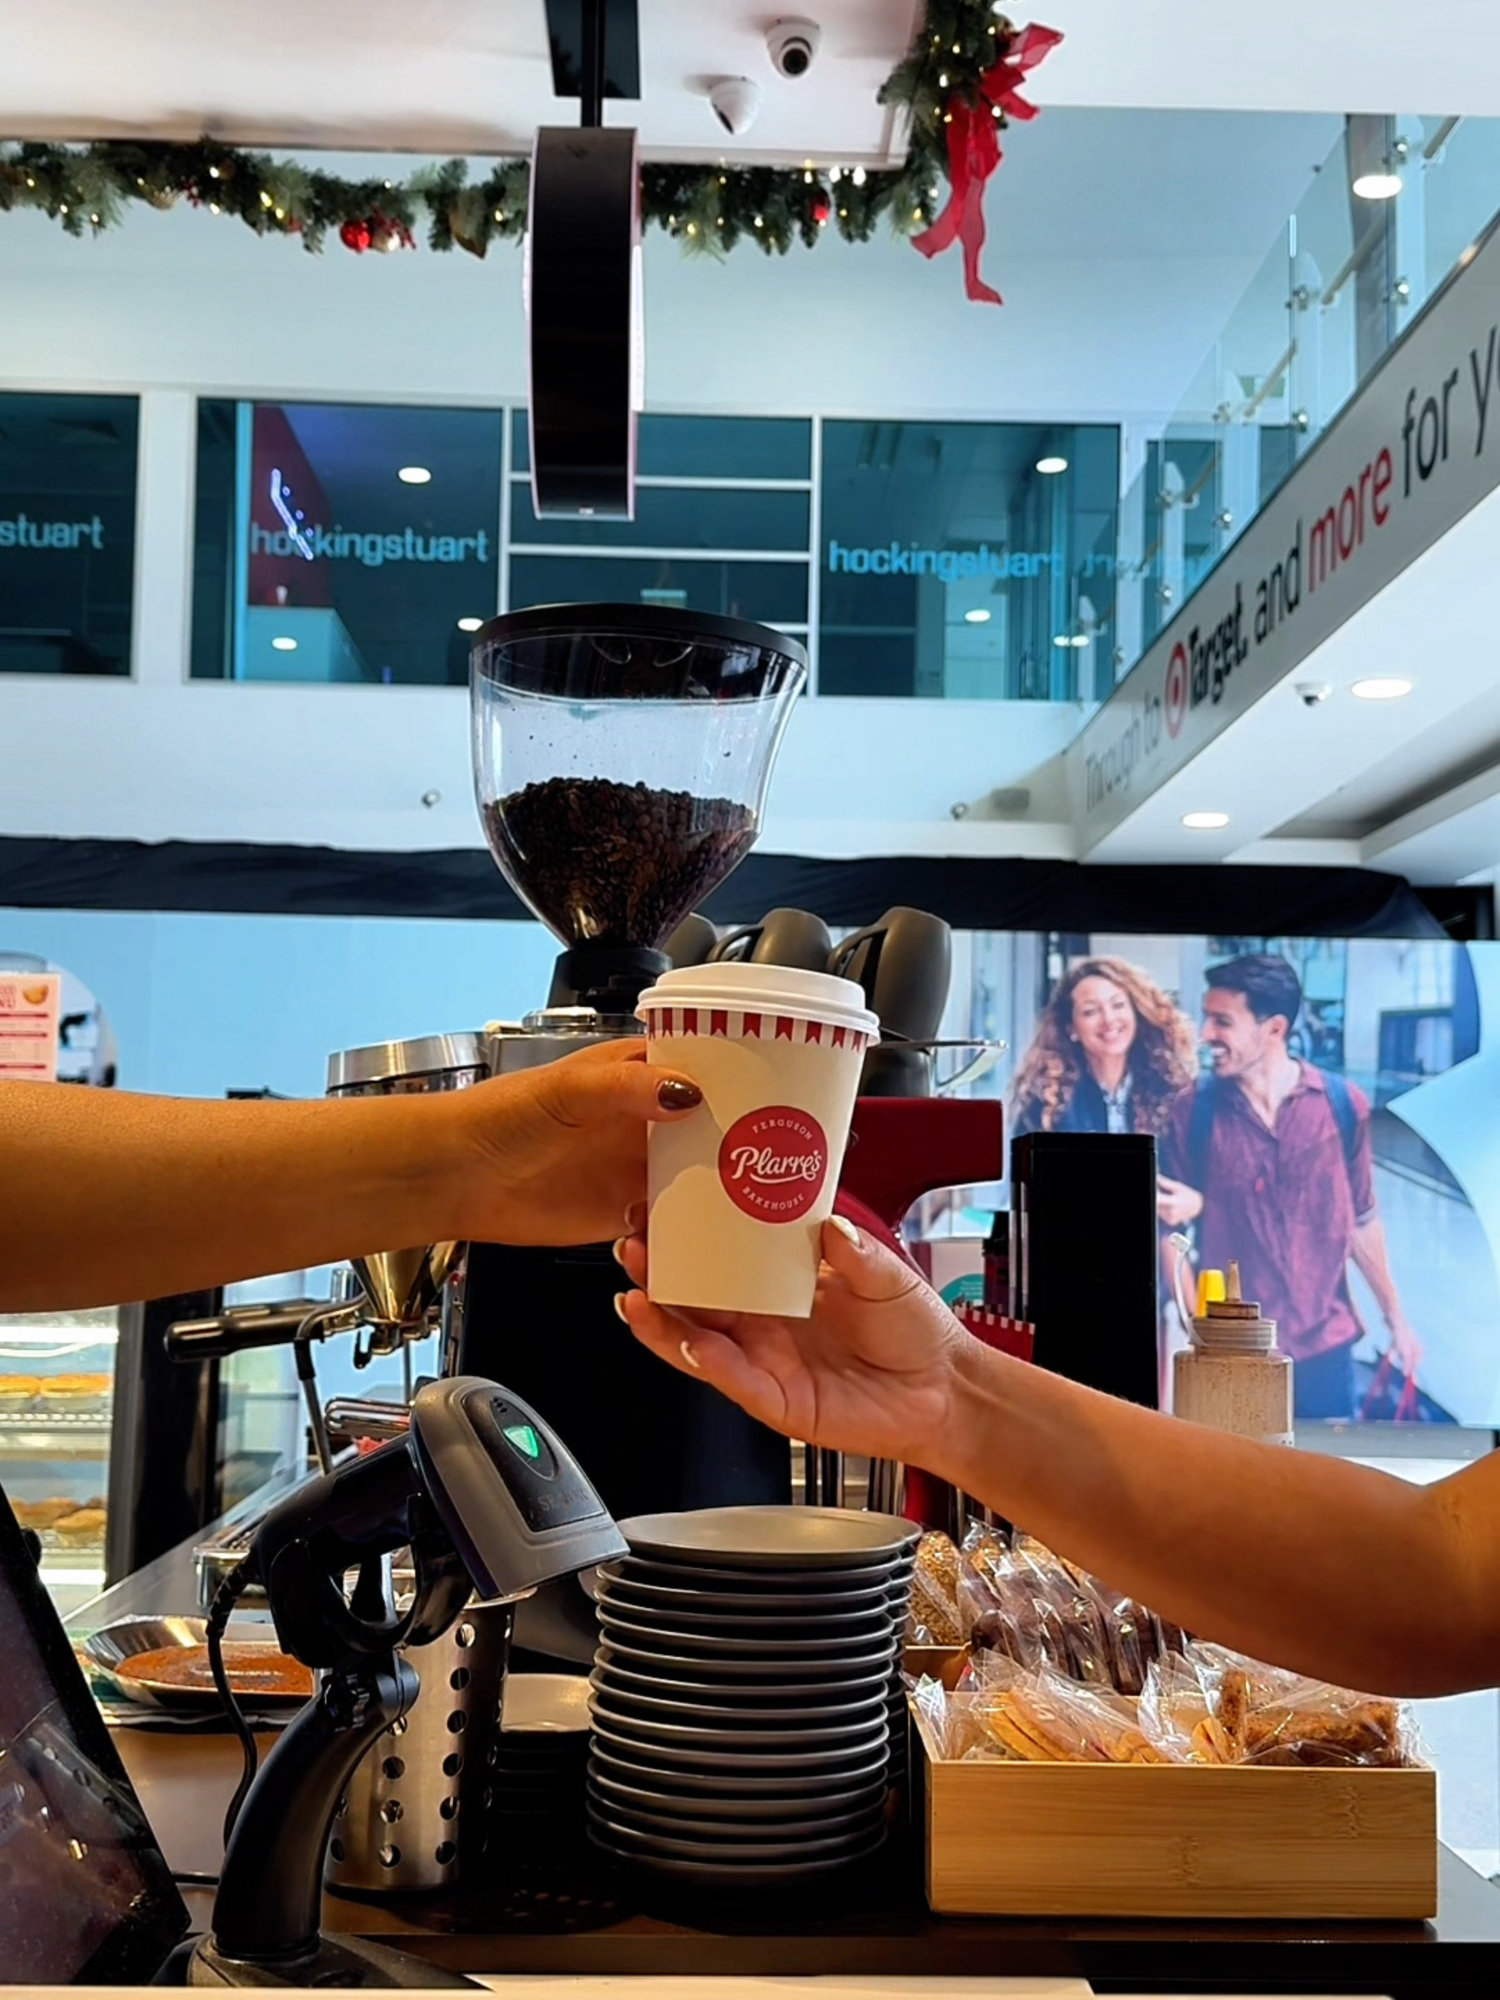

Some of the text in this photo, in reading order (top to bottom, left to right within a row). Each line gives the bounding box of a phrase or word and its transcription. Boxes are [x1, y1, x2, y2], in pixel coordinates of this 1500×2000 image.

[829, 540, 1063, 582] hockingstuart
[1144, 689, 1162, 755] to
[1254, 515, 1301, 645] and
[1308, 447, 1393, 595] more
[1402, 367, 1459, 498] for
[752, 1119, 813, 1140] FERGUSON
[730, 1146, 822, 1184] Plarre's
[742, 1186, 804, 1210] BAKEHOUSE
